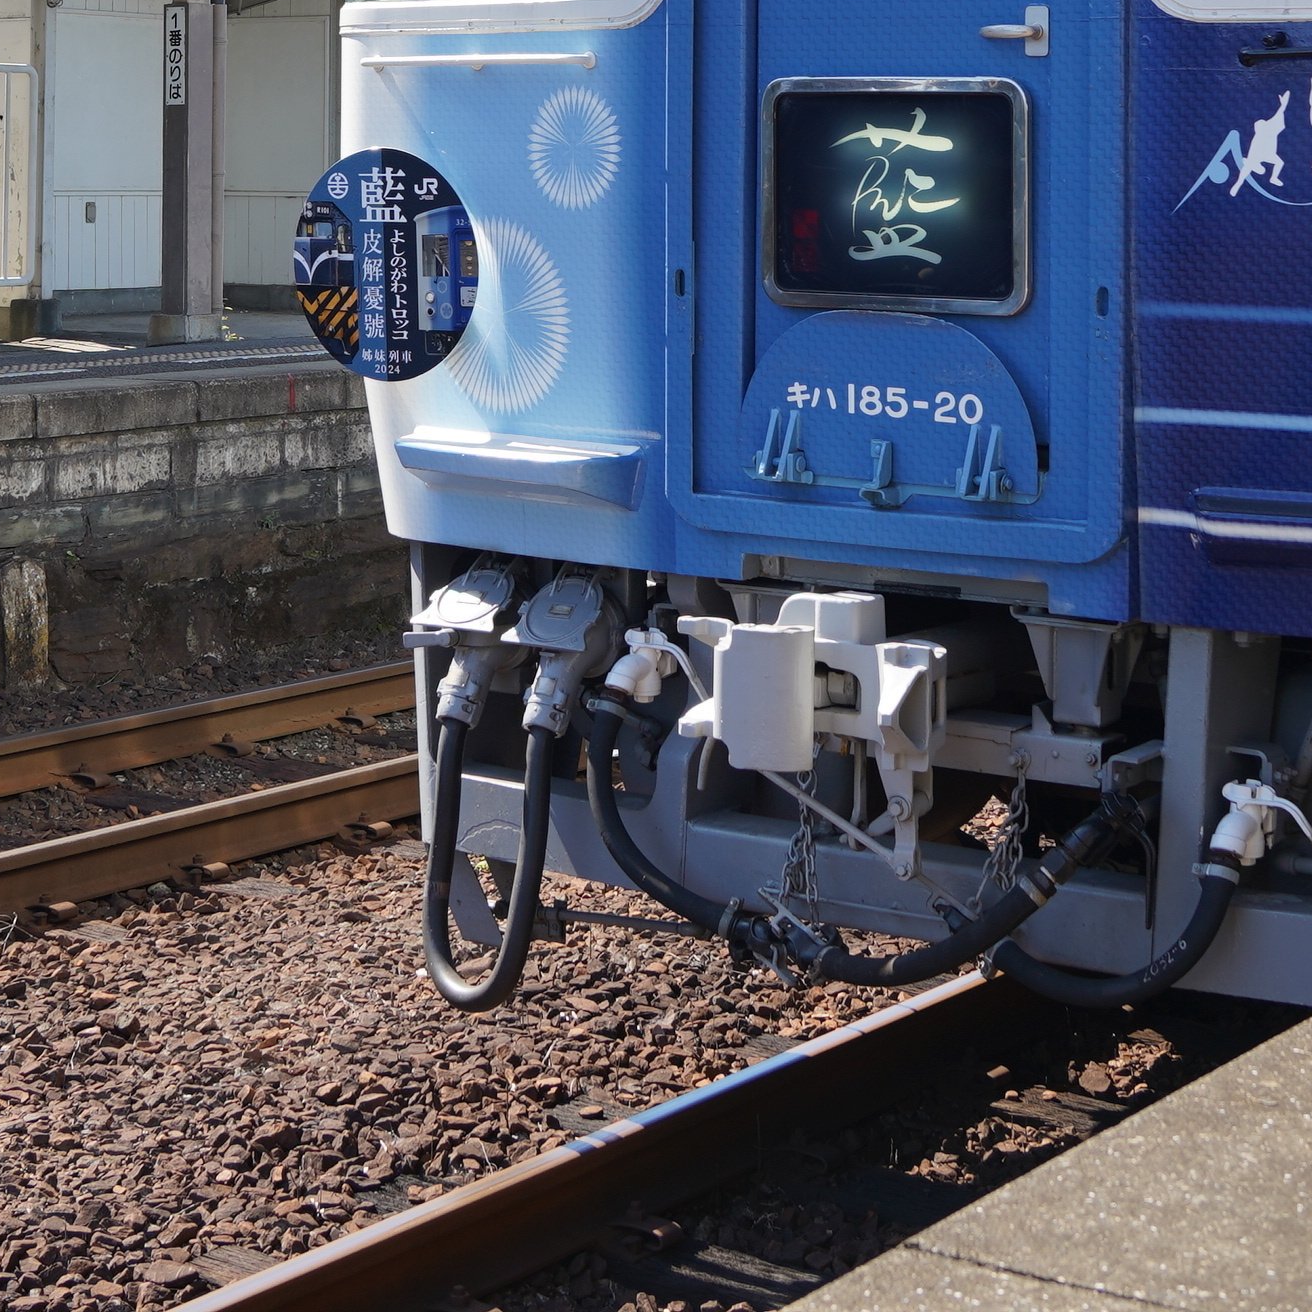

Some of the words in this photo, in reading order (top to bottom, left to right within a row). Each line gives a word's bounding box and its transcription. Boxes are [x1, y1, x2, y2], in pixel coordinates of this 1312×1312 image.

[169, 13, 182, 100] 1番のりば
[357, 166, 408, 224] 藍
[414, 177, 439, 195] JR
[828, 106, 961, 265] 藍
[389, 228, 410, 340] よしのがわトロッコ
[374, 364, 401, 374] 2024
[786, 381, 838, 411] キハ
[847, 382, 984, 426] 185-20
